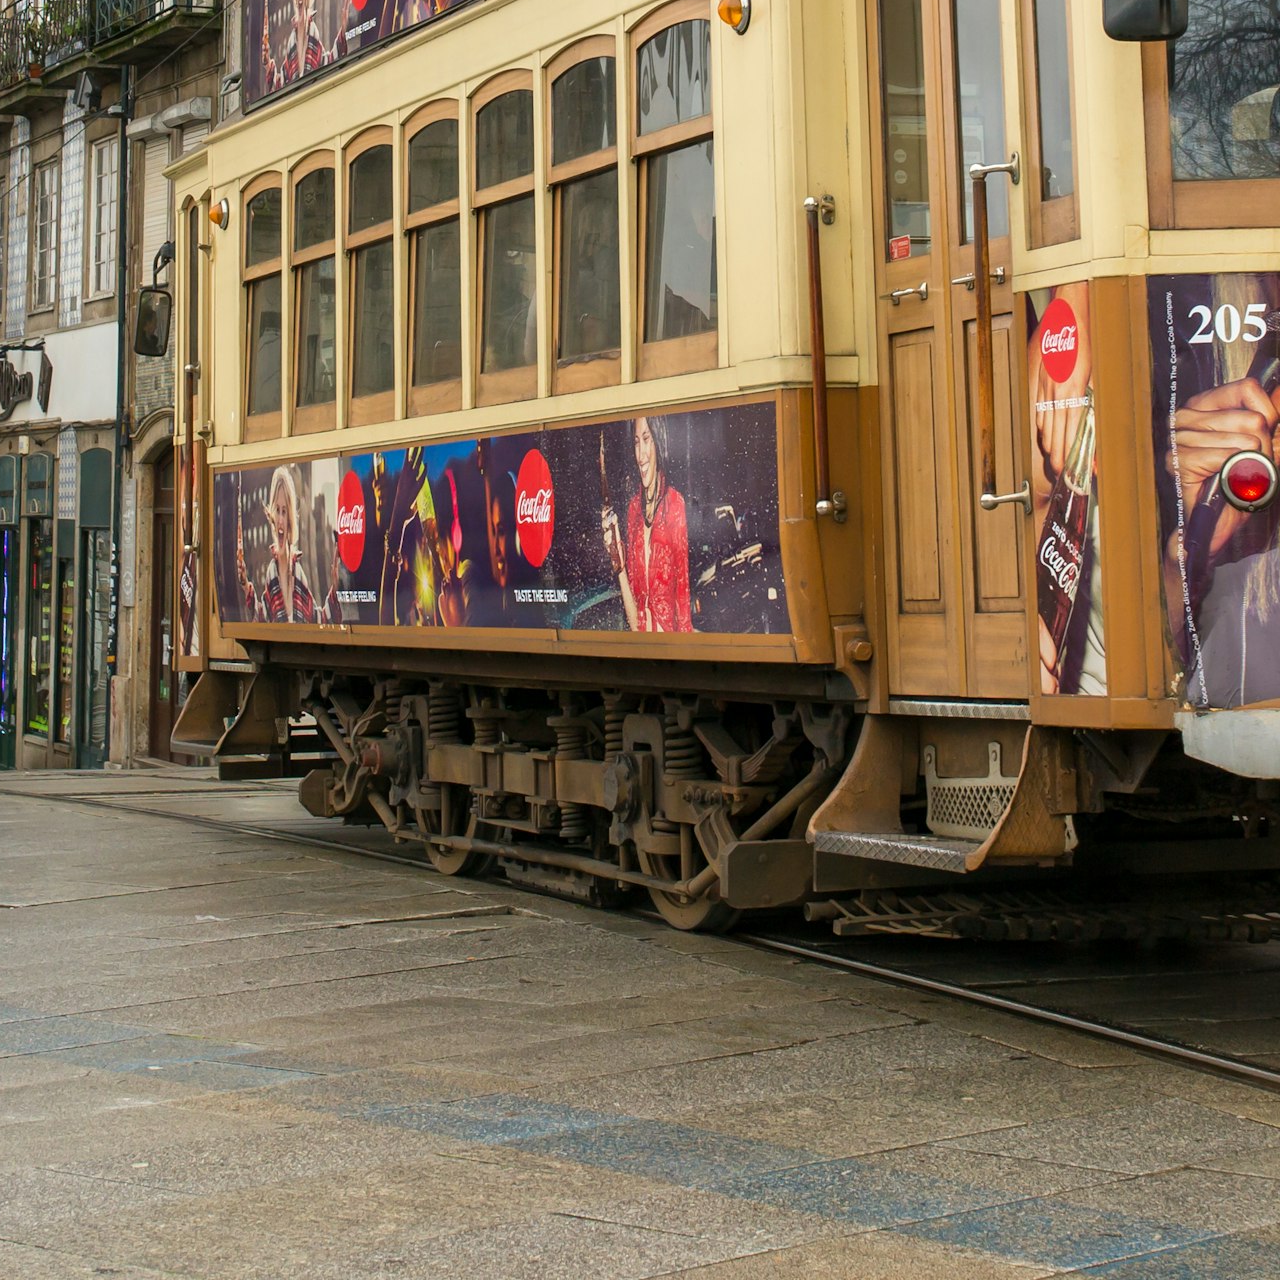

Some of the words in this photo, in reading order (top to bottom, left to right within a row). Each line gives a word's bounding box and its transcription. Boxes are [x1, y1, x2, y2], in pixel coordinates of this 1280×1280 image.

[1188, 303, 1267, 344] 205
[1168, 325, 1177, 364] Coca-Cola
[1170, 381, 1177, 391] da
[1036, 400, 1053, 412] TASTE
[1053, 398, 1066, 409] THE
[1170, 429, 1178, 455] marcas
[1174, 470, 1183, 498] contour
[1176, 498, 1184, 527] garrafa
[1177, 543, 1187, 580] vermelho
[514, 590, 532, 602] TASTE
[532, 590, 543, 602] THE
[543, 590, 568, 603] FEELING
[1182, 582, 1190, 605] disco
